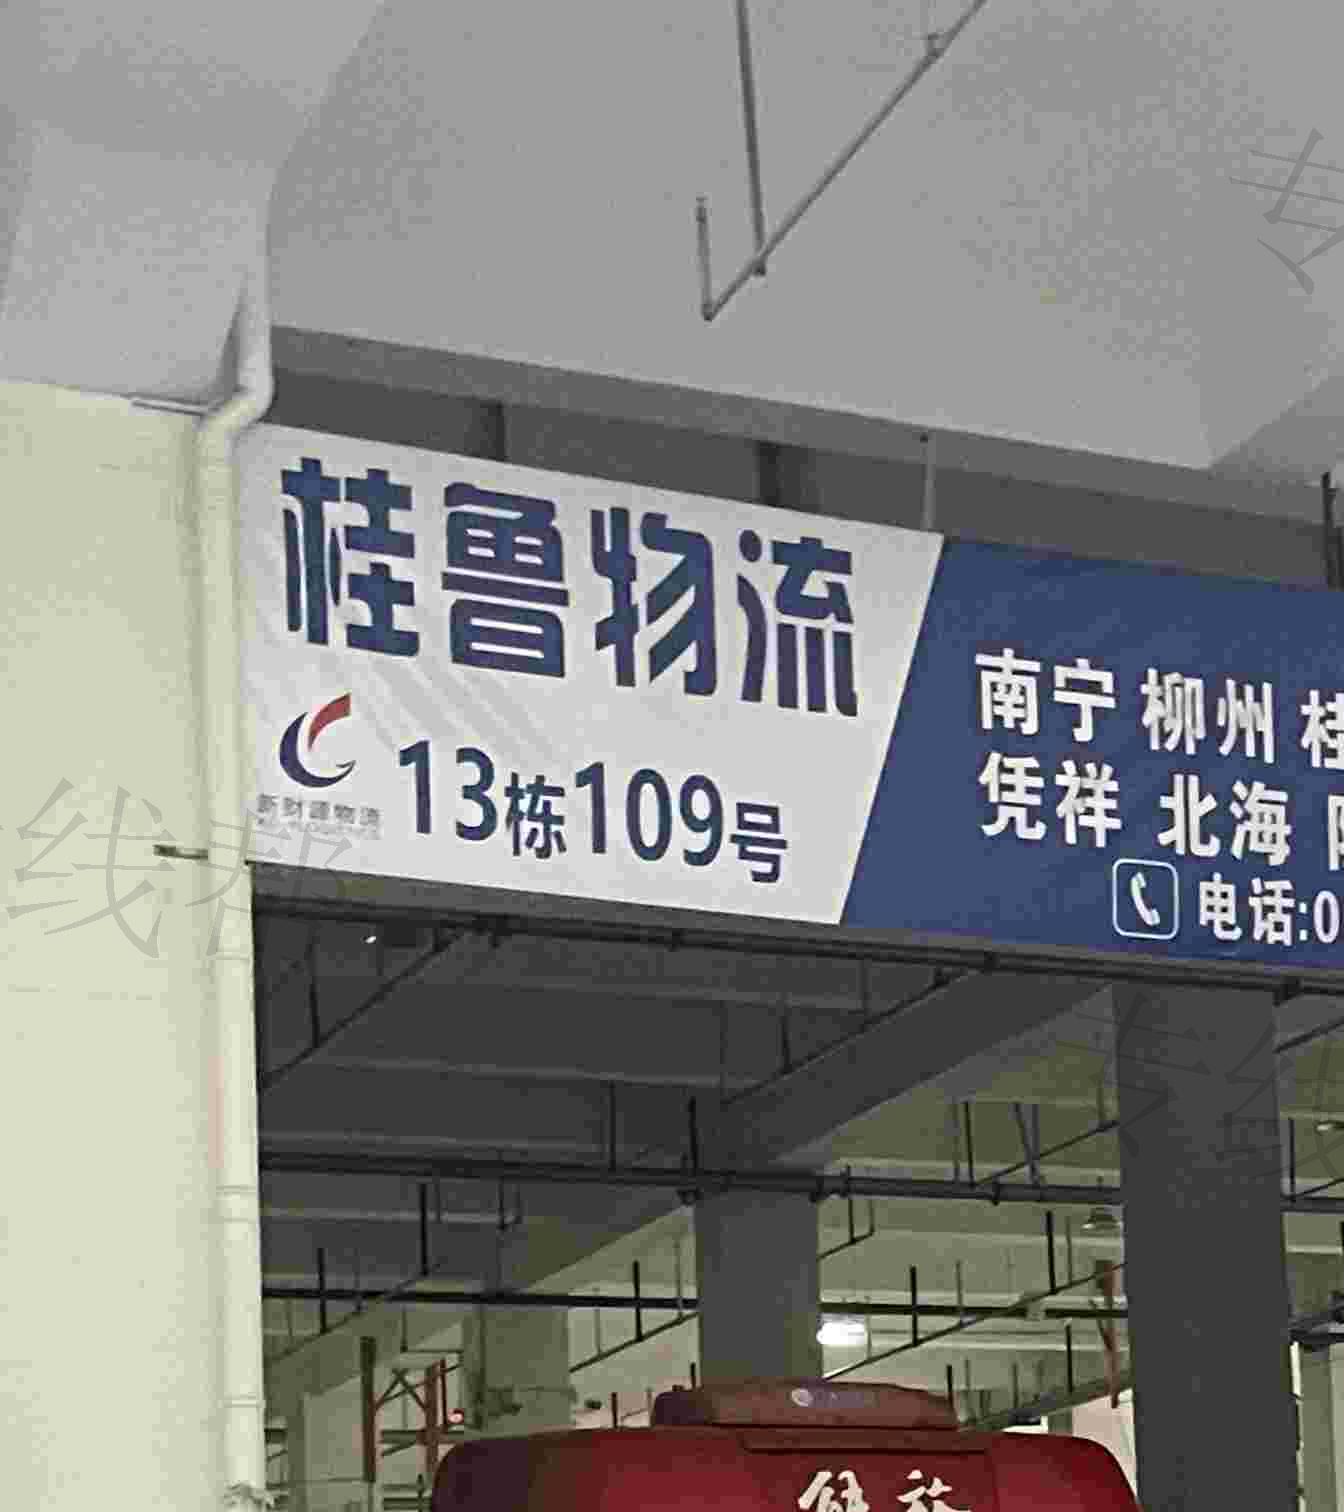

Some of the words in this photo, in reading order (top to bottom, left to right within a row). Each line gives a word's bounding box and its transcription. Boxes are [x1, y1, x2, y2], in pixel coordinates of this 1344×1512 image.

[281, 457, 858, 717] 桂鲁物流
[975, 648, 1116, 741] 南宁
[1142, 668, 1275, 763] 柳州
[399, 741, 787, 883] 13栋109号
[980, 751, 1122, 847] 凭祥
[1158, 773, 1292, 866] 北海
